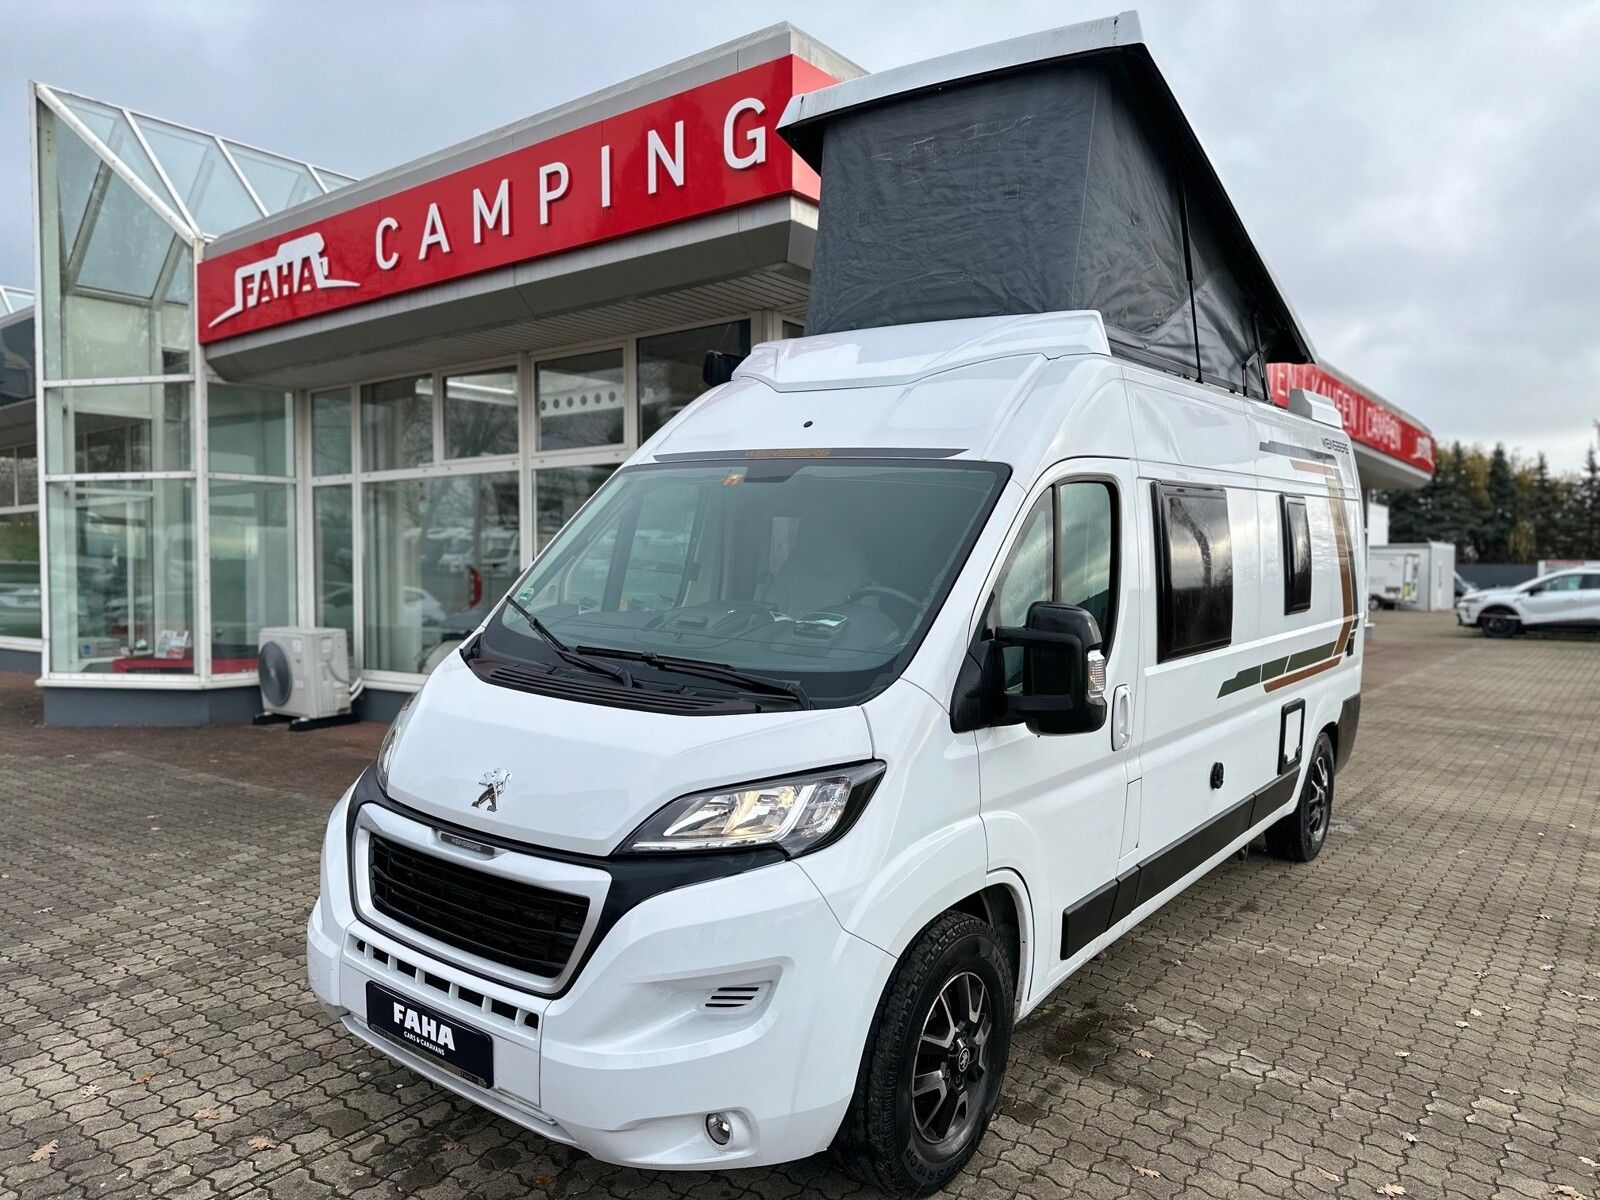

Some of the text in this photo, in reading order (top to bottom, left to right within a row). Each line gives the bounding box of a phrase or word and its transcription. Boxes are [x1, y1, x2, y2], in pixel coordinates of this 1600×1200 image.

[374, 97, 768, 271] CAMPING
[393, 1001, 456, 1051] FAHA
[403, 1030, 416, 1042] CARS
[420, 1038, 445, 1056] CARAVANS
